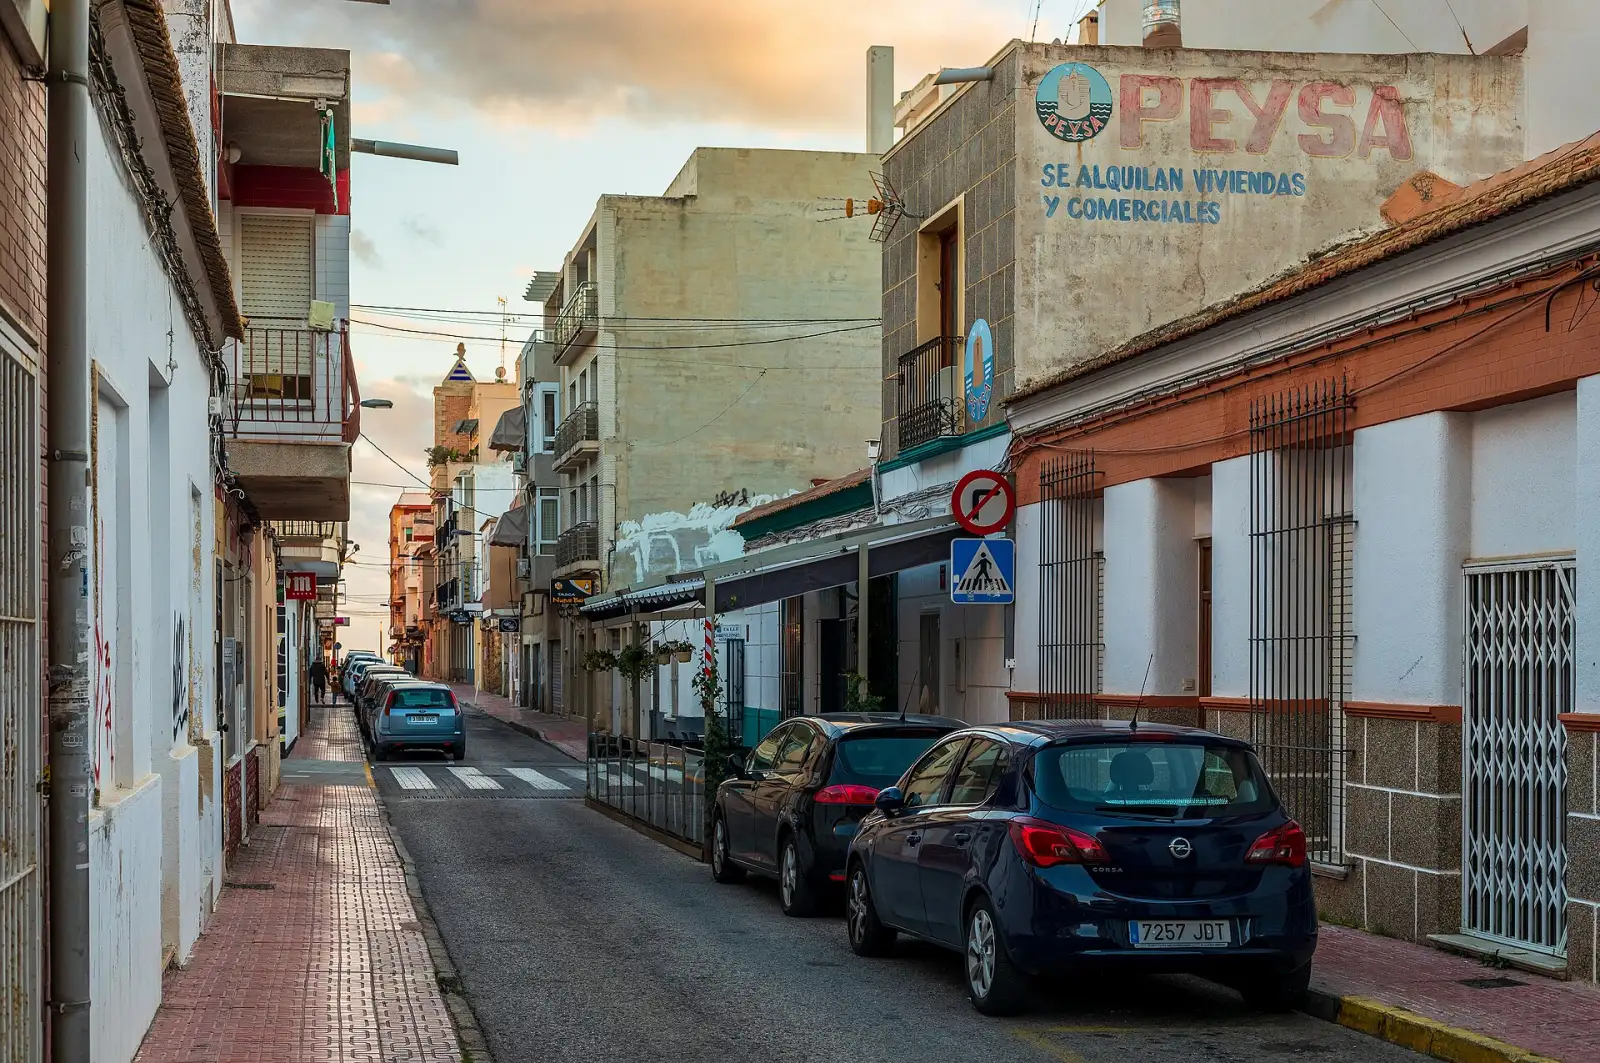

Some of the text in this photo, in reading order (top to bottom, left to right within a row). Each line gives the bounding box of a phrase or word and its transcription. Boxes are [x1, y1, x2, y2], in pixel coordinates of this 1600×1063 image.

[1045, 113, 1104, 140] PEYSA
[1120, 74, 1414, 162] PEYSA
[1041, 163, 1307, 197] SE ALQUILAN VIVIENDAS
[1043, 195, 1221, 225] Y COMERCIALES
[1142, 923, 1225, 941] 7257 JDT
